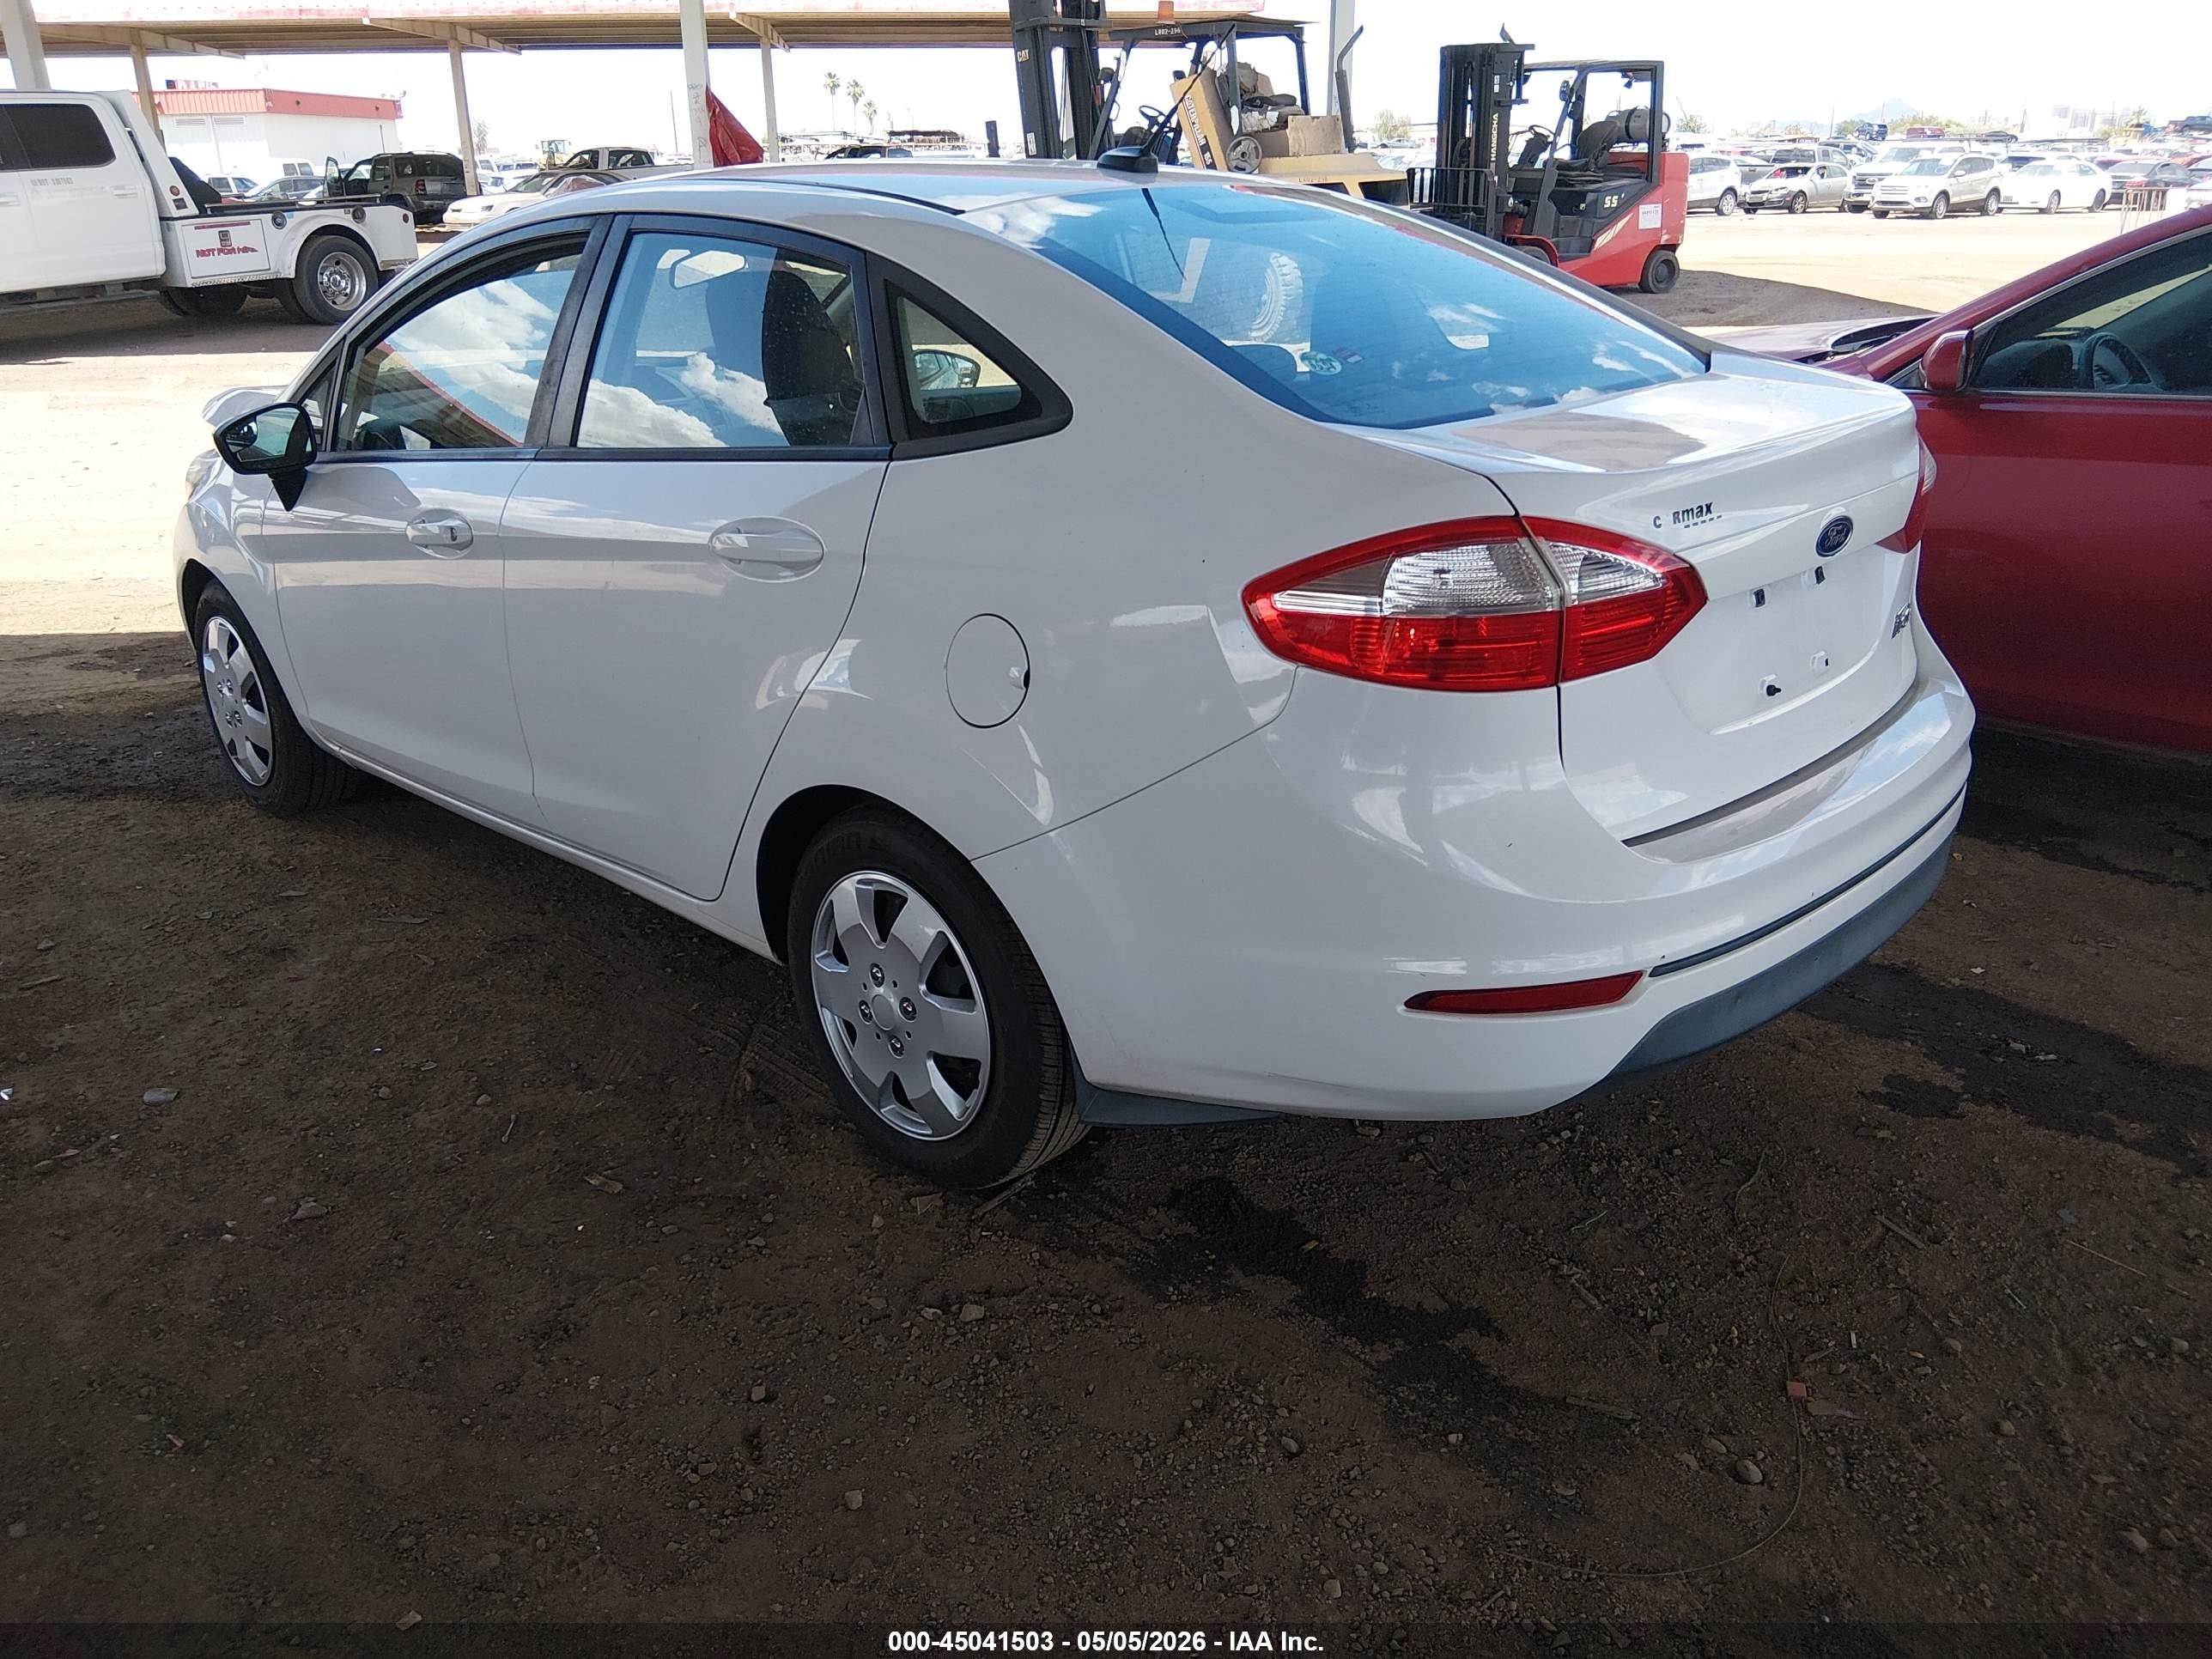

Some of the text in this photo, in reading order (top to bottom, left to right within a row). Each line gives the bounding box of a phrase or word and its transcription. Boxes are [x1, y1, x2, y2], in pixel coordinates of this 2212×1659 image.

[1017, 49, 1030, 63] CAT
[1184, 95, 1206, 146] CATERPILLAR
[1490, 112, 1499, 161] HANGCHA
[195, 248, 216, 258] NOT
[216, 246, 236, 256] FOR
